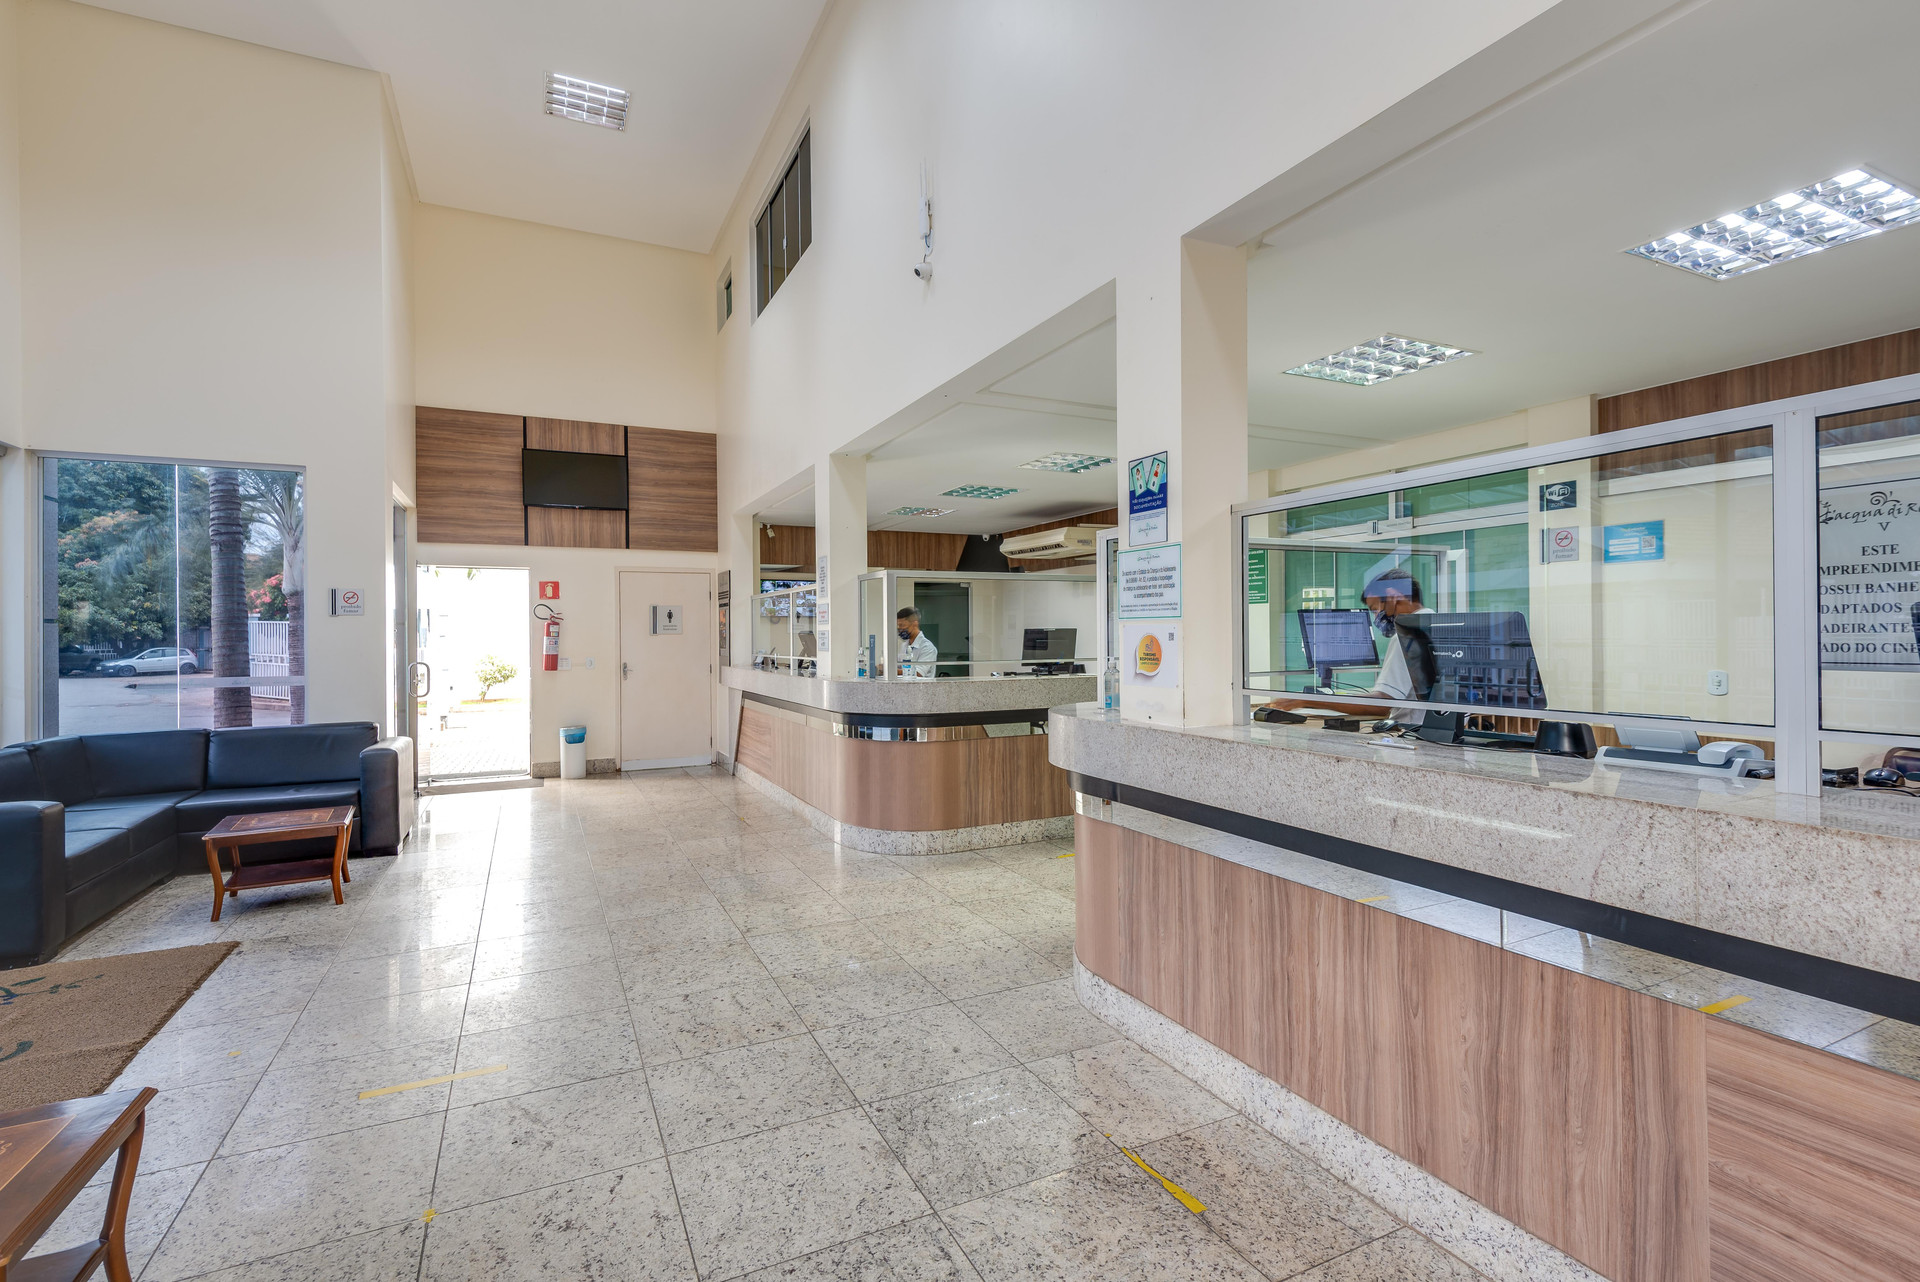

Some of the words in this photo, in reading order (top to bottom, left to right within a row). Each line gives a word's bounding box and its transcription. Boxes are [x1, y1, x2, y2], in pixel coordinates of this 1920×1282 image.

[1888, 503, 1903, 518] di
[1905, 503, 1920, 516] R
[1878, 522, 1891, 531] V
[1861, 544, 1899, 556] ESTE
[1865, 582, 1919, 593] BANHE
[1821, 602, 1902, 614] DAPTADOS
[1821, 623, 1914, 633] ADEIRANTE
[1821, 643, 1851, 653] ADO
[1855, 643, 1877, 653] DO
